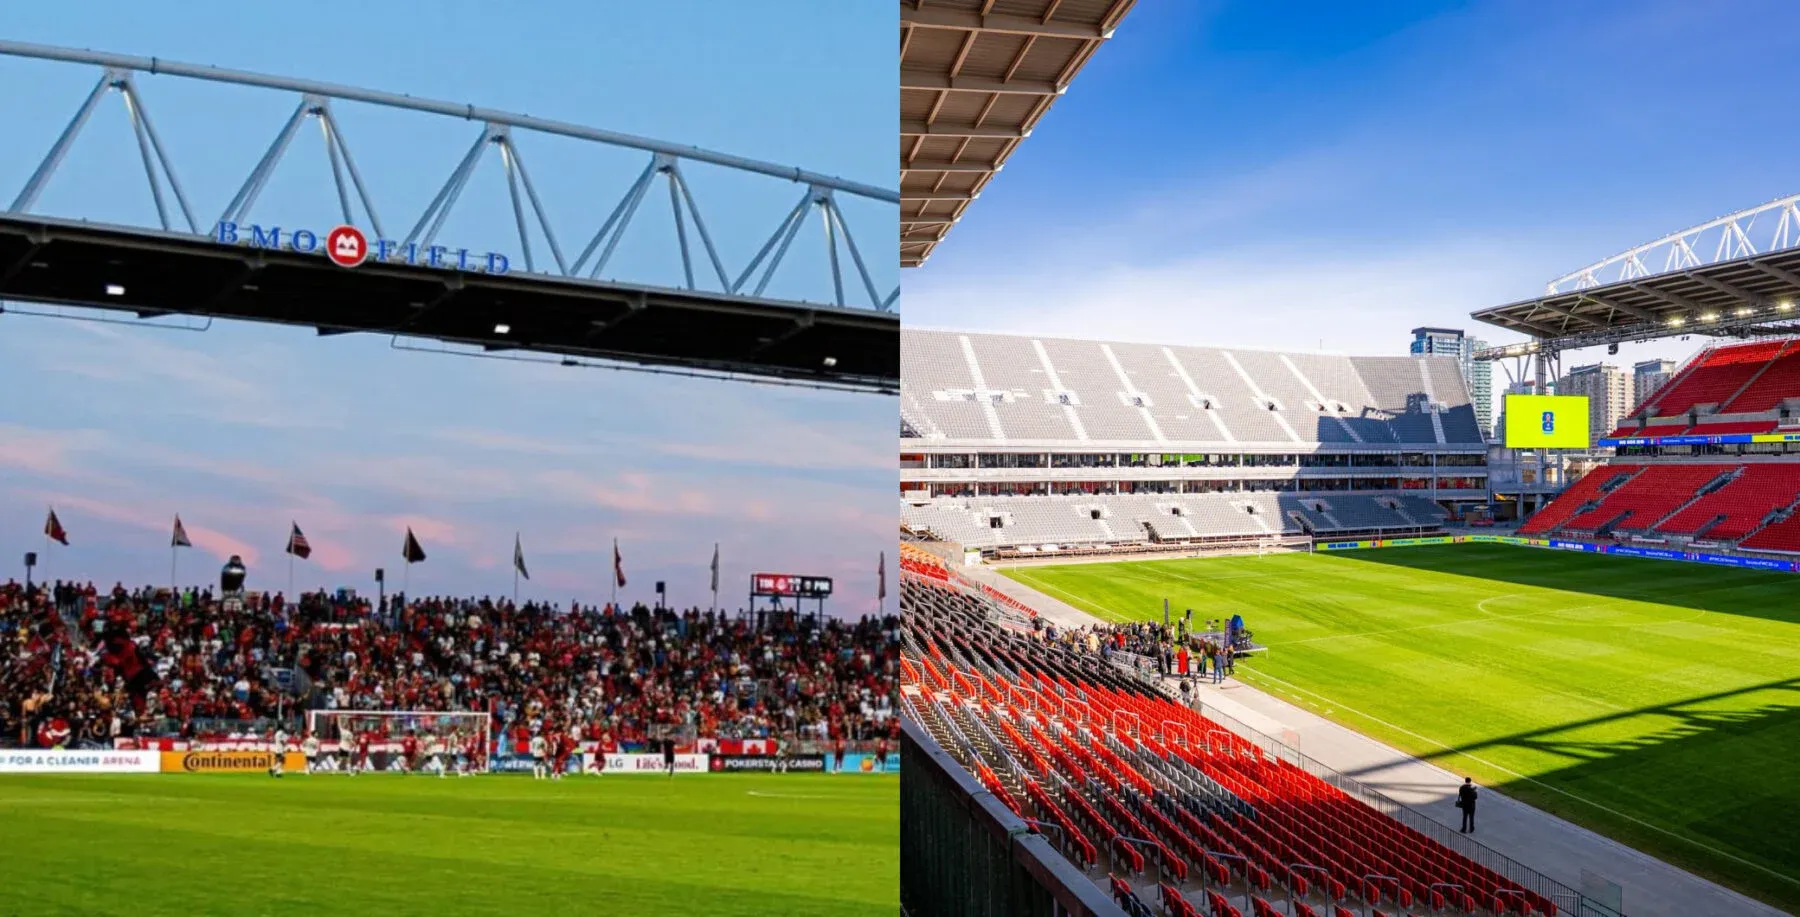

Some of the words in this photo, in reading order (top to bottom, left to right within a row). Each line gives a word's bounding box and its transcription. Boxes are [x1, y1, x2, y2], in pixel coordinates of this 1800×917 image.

[216, 220, 318, 251] BMO
[377, 238, 510, 276] FIELD
[9, 756, 33, 765] FOR
[35, 756, 44, 765] A
[46, 756, 100, 766] CLEANER
[103, 756, 142, 765] ARENA
[183, 751, 272, 772] Continental
[609, 757, 625, 769] LG
[636, 757, 663, 770] Life's
[669, 757, 699, 770] ood.
[725, 759, 787, 768] POKERSTA
[788, 759, 823, 768] CASINO
